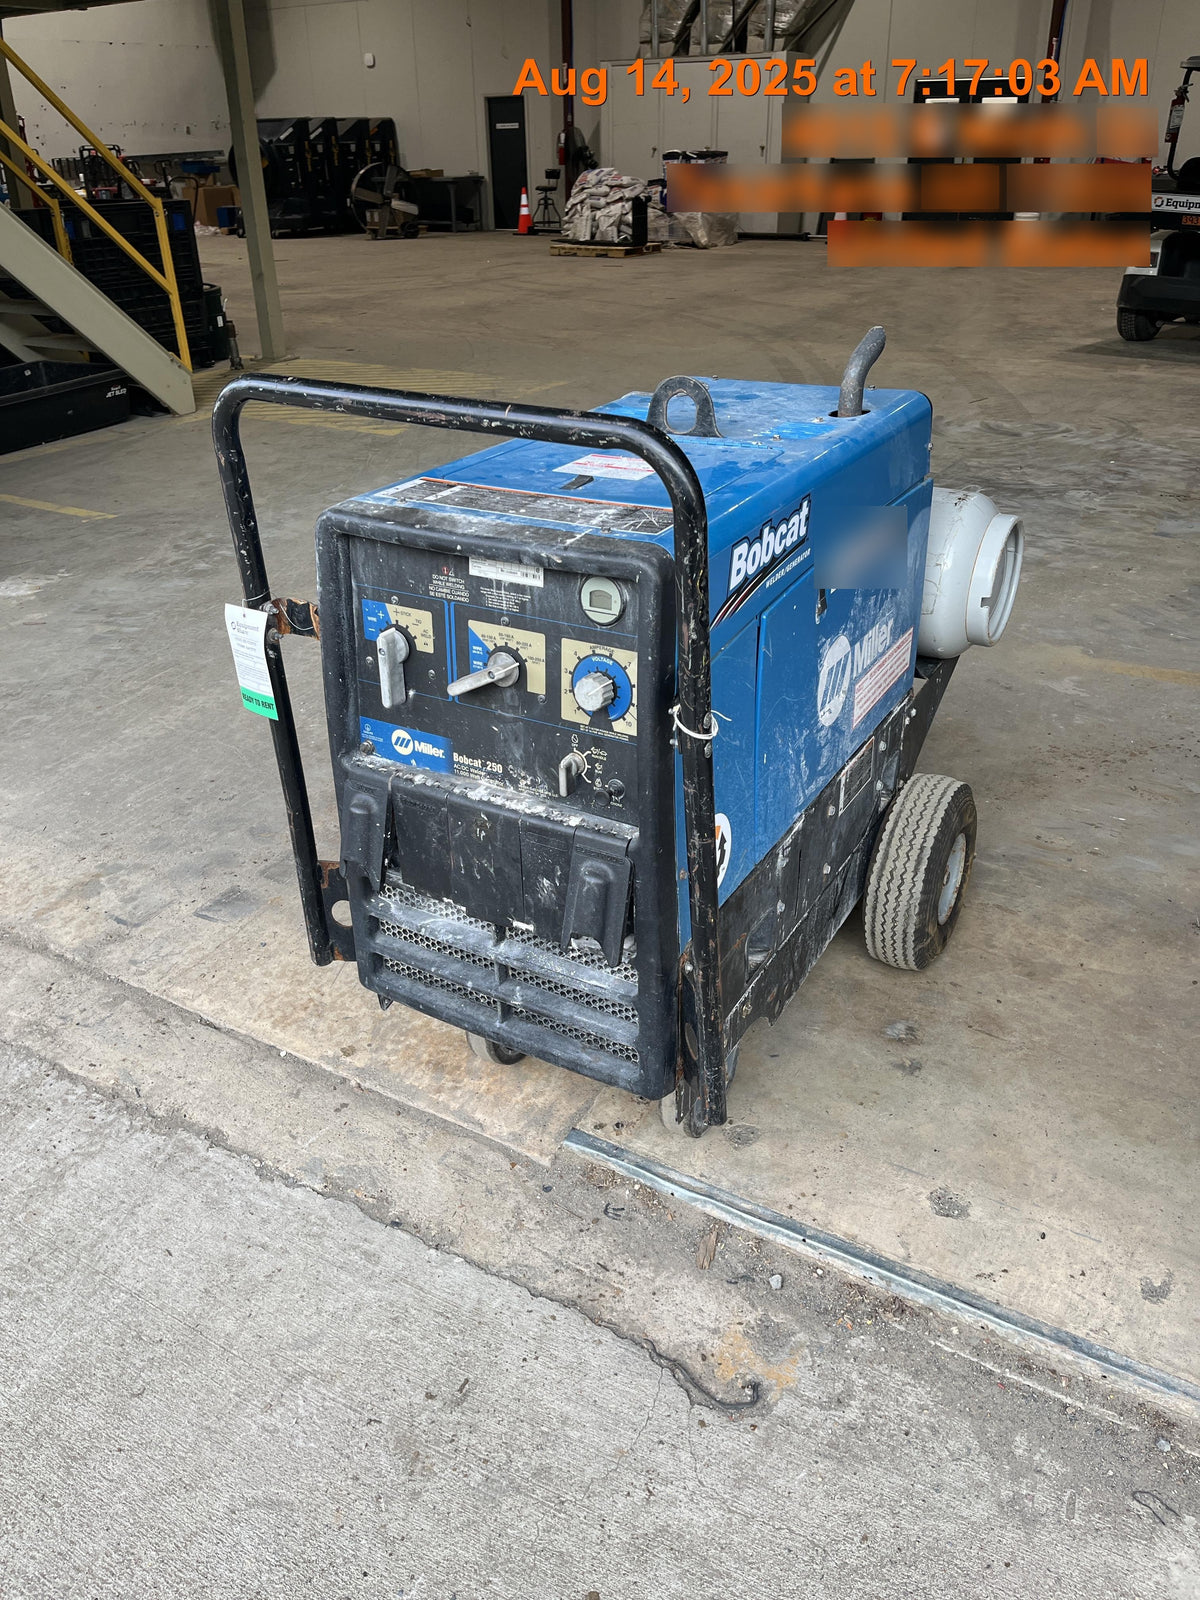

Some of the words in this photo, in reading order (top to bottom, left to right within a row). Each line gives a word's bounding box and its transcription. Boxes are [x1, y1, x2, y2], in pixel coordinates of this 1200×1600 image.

[729, 499, 810, 592] Bobcat
[765, 548, 811, 589] WELDER/GENERATOR
[447, 594, 470, 603] SOLDANDO
[589, 645, 615, 655] AMPERAGE
[853, 617, 894, 680] Miller
[591, 657, 614, 666] VOLTAGE
[242, 693, 255, 704] READY
[254, 698, 261, 706] TO
[261, 700, 274, 710] RENT
[453, 763, 469, 772] AC/DC
[486, 760, 503, 774] 250
